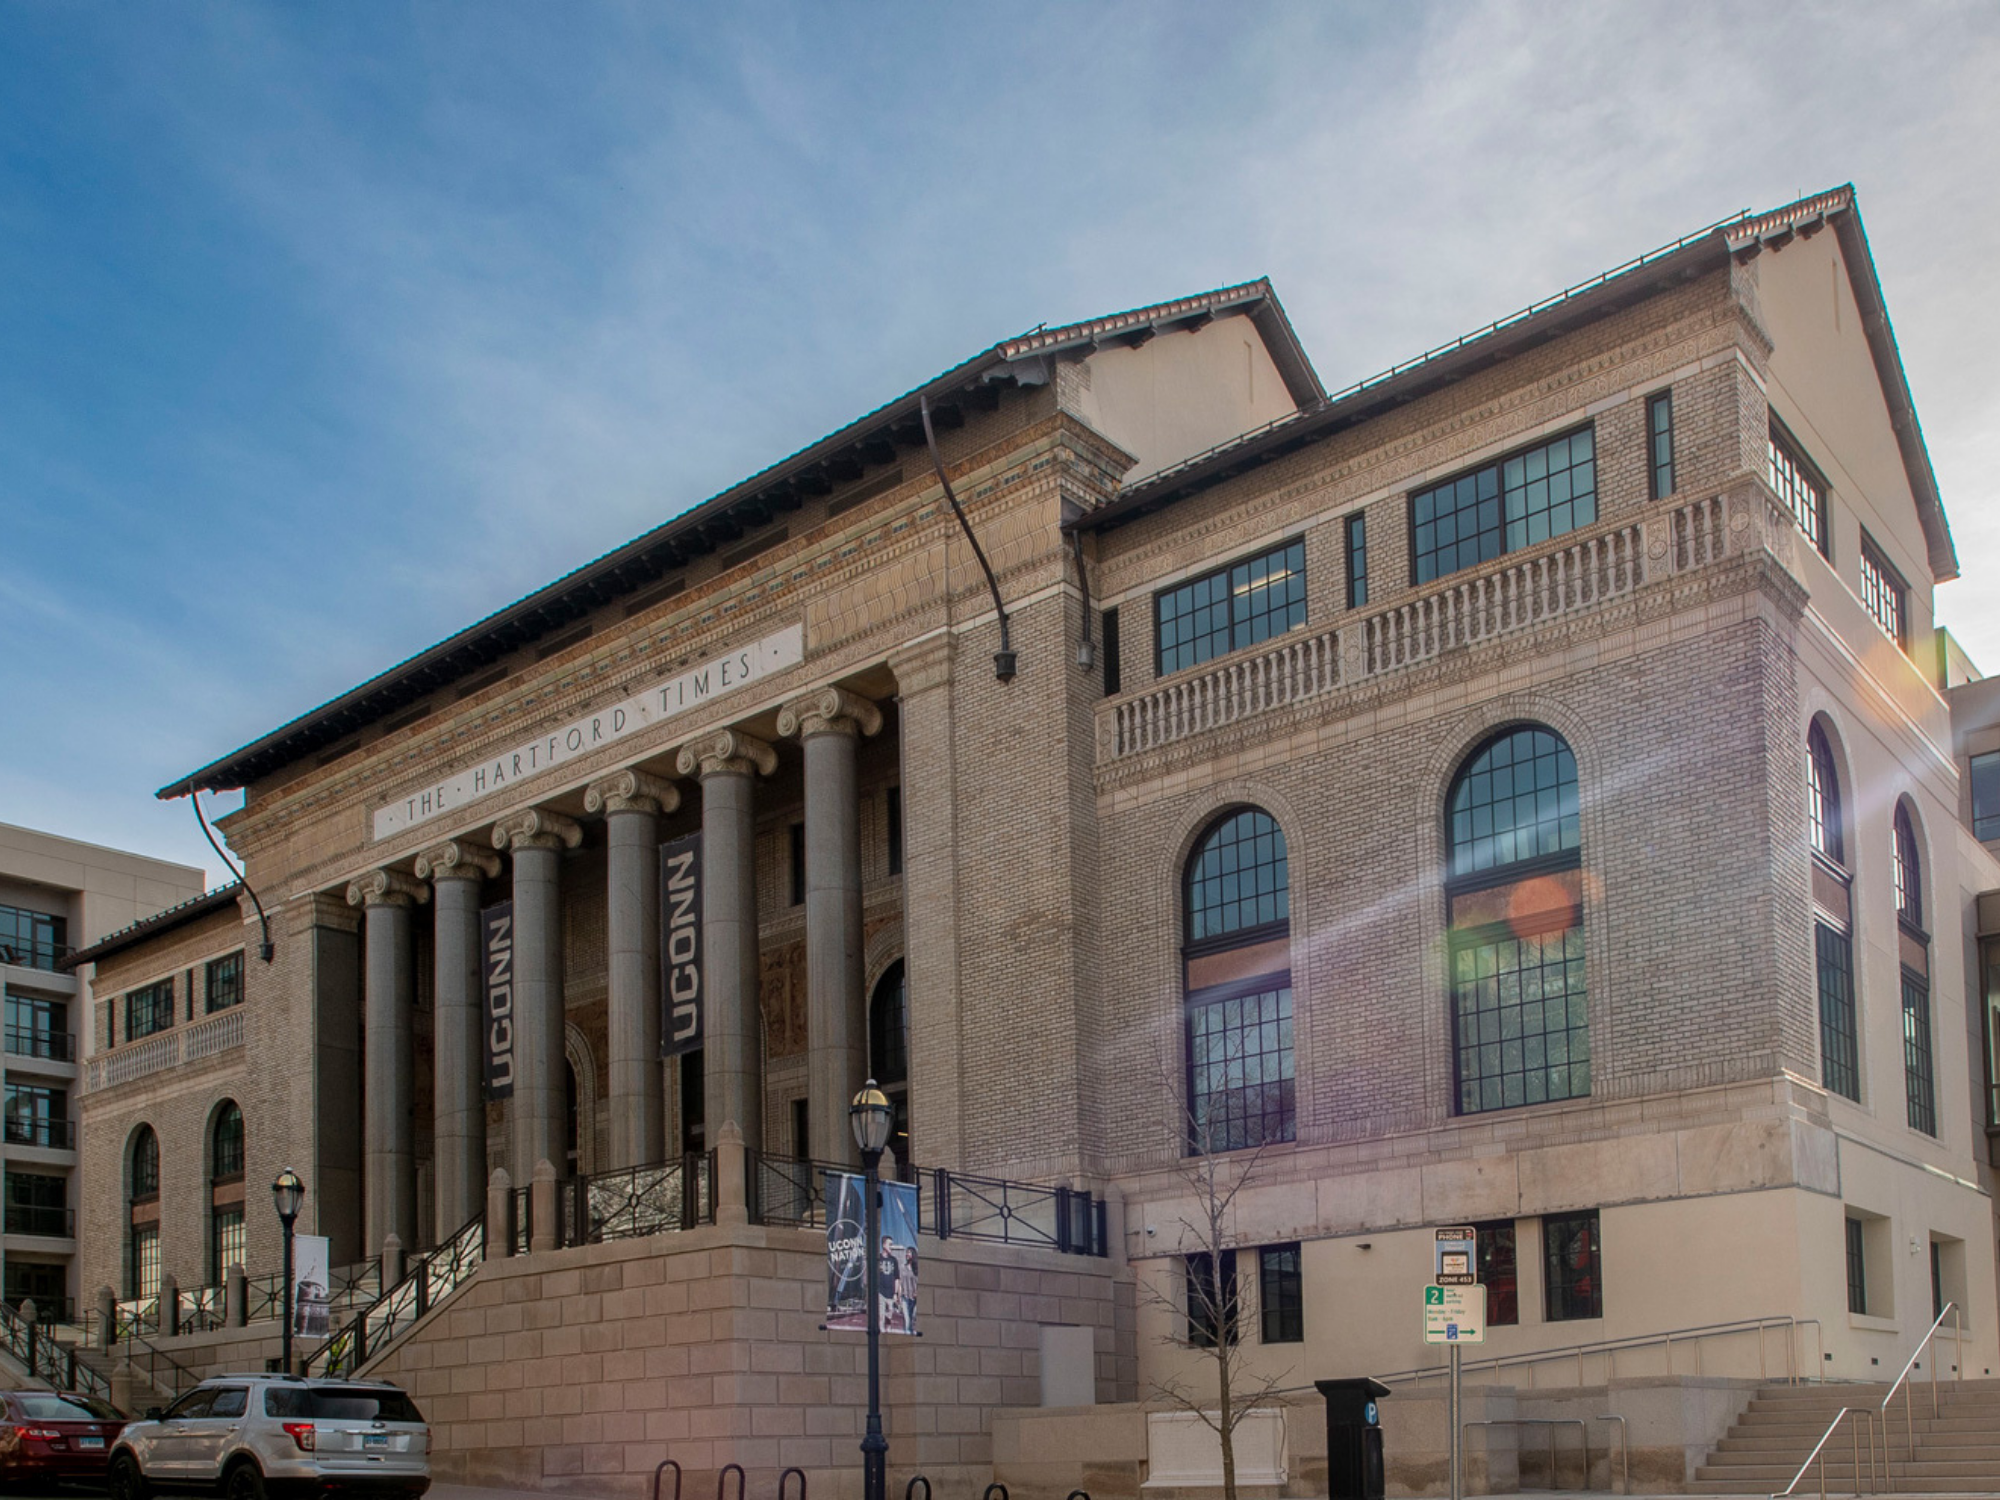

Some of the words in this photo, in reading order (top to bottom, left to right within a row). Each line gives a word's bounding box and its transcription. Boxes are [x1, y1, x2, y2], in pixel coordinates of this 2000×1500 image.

[406, 785, 446, 821] THE
[474, 709, 627, 792] HARTFORD
[659, 652, 750, 712] TIMES
[668, 850, 699, 1042] UCONN
[488, 915, 514, 1088] UCONN
[828, 1236, 863, 1251] UCONN
[831, 1248, 865, 1262] NATION
[1430, 1290, 1439, 1304] 2
[1368, 1402, 1376, 1423] P
